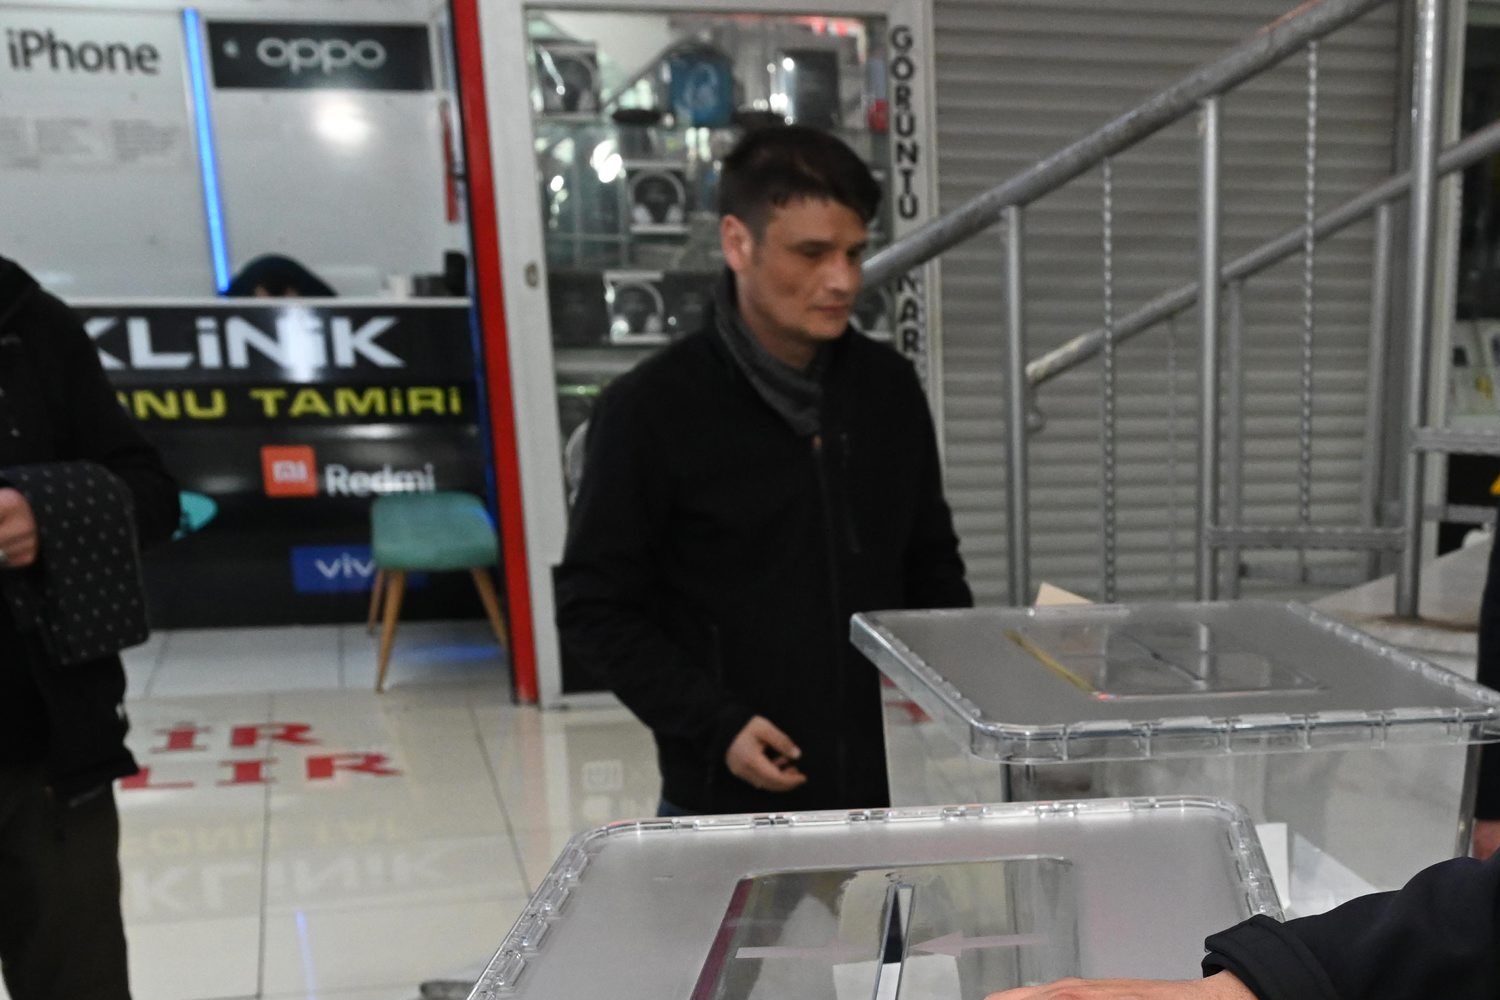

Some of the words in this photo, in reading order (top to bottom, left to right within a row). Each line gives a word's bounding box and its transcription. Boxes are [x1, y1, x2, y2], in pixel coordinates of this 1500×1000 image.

[6, 28, 160, 75] iPhone
[257, 37, 386, 74] oppo
[116, 388, 227, 420] NU
[324, 462, 437, 496] Redmi
[314, 553, 375, 578] viv
